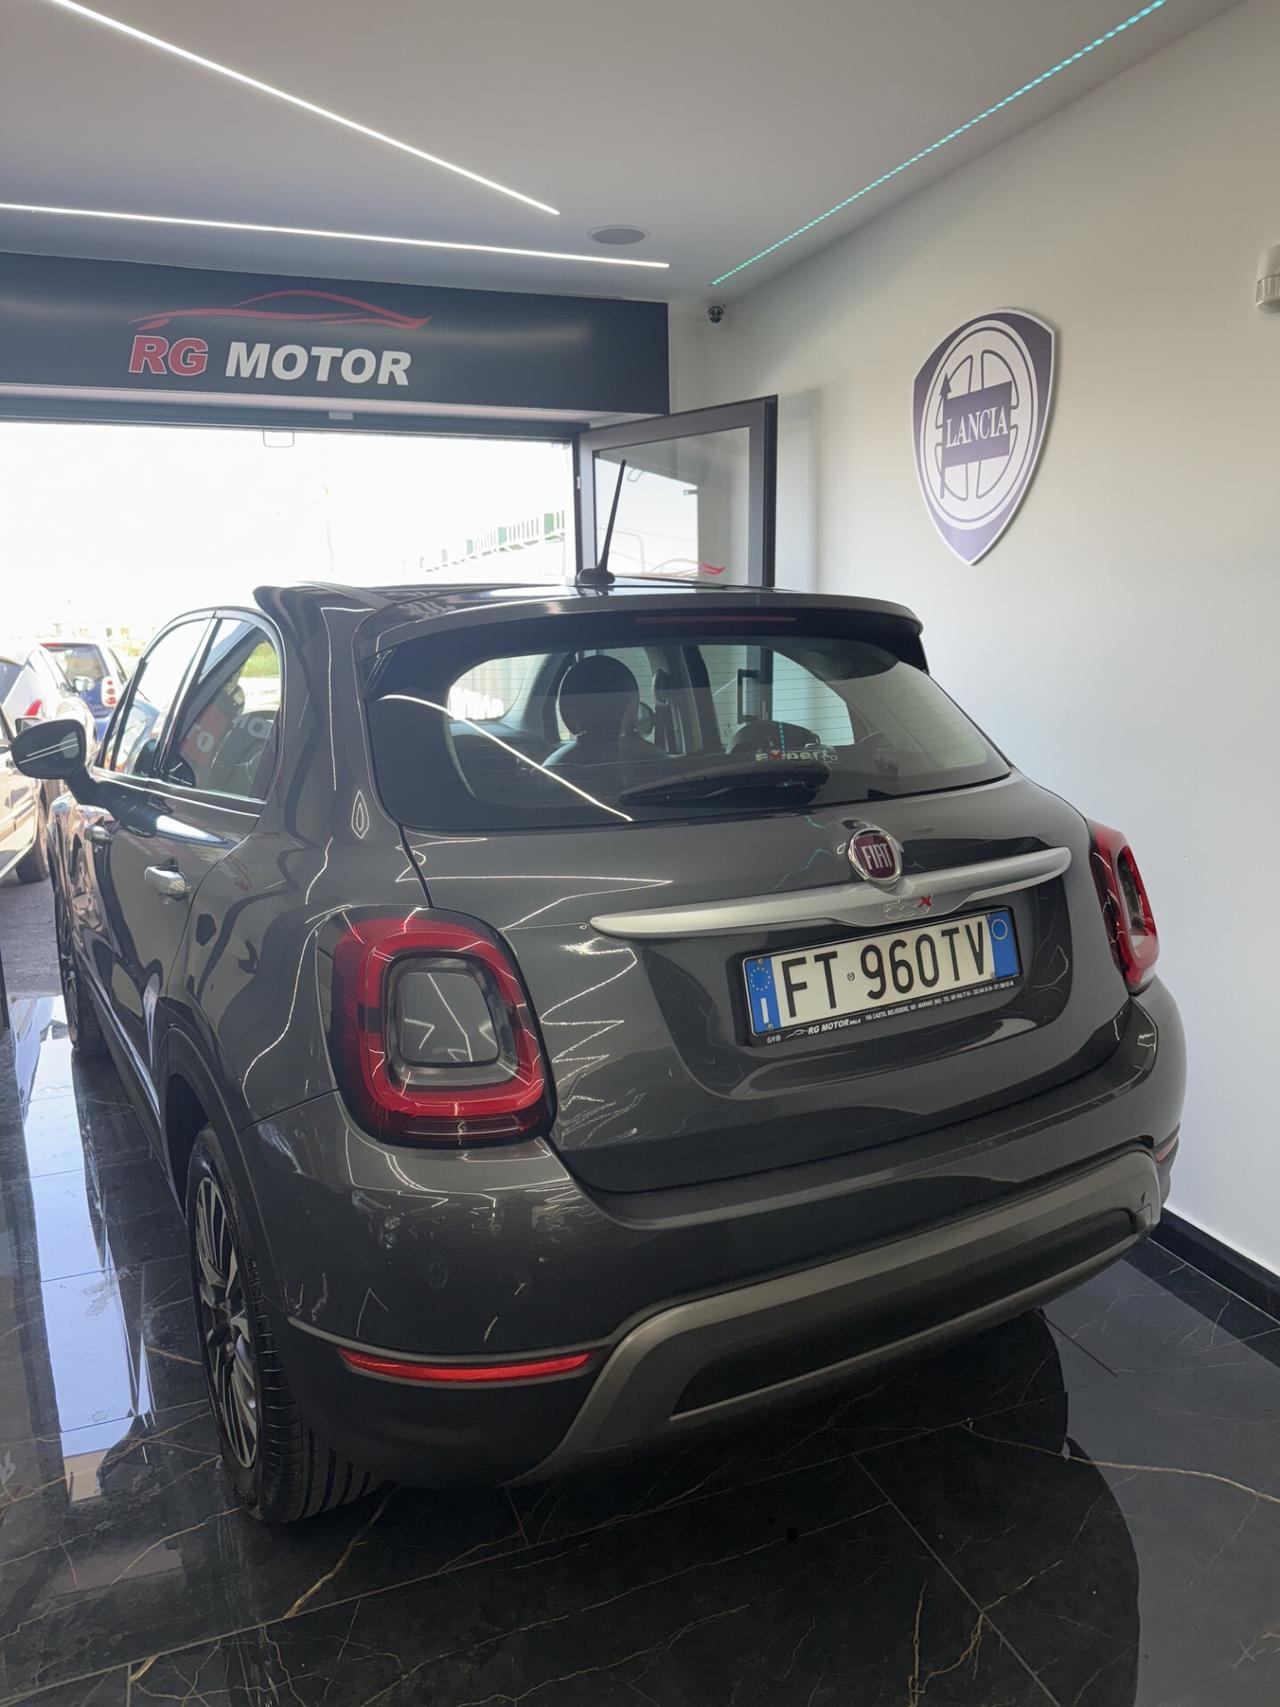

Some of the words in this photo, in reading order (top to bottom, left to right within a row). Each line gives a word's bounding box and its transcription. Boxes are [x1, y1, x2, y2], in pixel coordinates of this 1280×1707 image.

[128, 334, 208, 376] RG
[225, 341, 412, 386] MOTOR
[946, 406, 1009, 448] LANCIA
[861, 843, 893, 870] FIAT
[781, 951, 838, 1018] FT
[808, 1025, 820, 1035] RG
[821, 1019, 850, 1032] MOTOR
